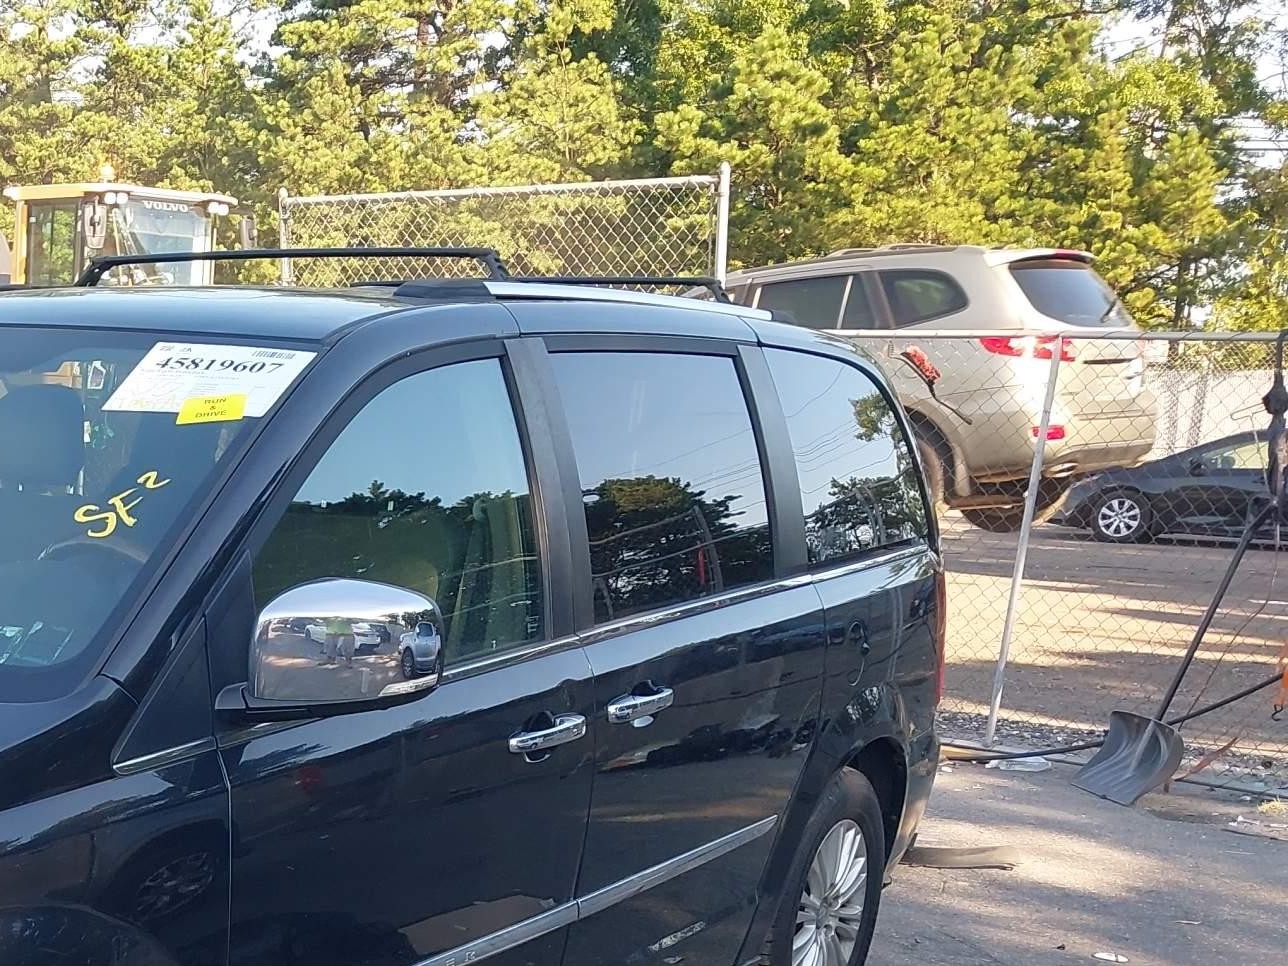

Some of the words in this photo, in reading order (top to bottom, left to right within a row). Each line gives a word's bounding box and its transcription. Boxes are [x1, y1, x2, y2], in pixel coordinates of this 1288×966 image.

[142, 200, 188, 213] VOLVO
[156, 355, 285, 374] 45819607
[195, 410, 228, 418] DRIVE
